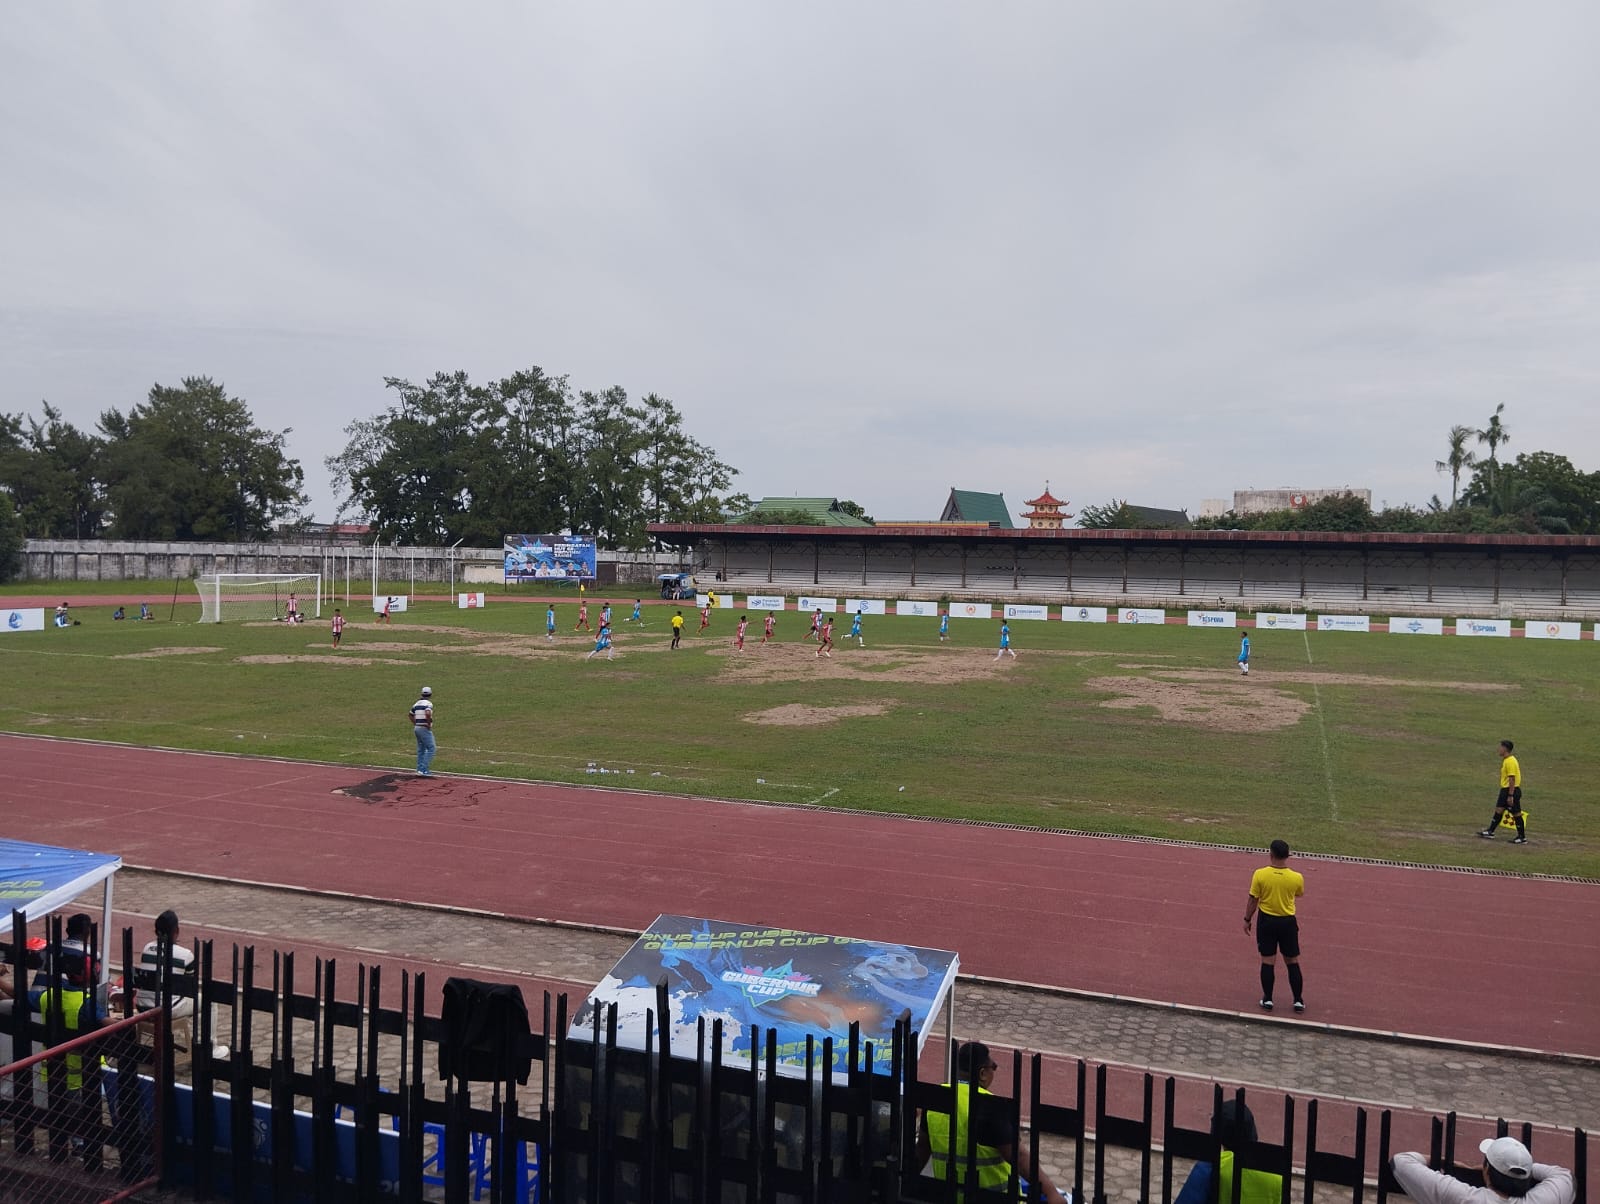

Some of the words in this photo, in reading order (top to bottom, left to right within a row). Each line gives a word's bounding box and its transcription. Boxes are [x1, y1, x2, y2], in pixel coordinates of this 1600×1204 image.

[696, 932, 737, 941] CUP
[740, 929, 812, 939] GUBER
[643, 938, 776, 950] GUBERNUR
[779, 937, 829, 947] CUP
[721, 970, 822, 996] GUBERNUR
[746, 983, 787, 996] CUP
